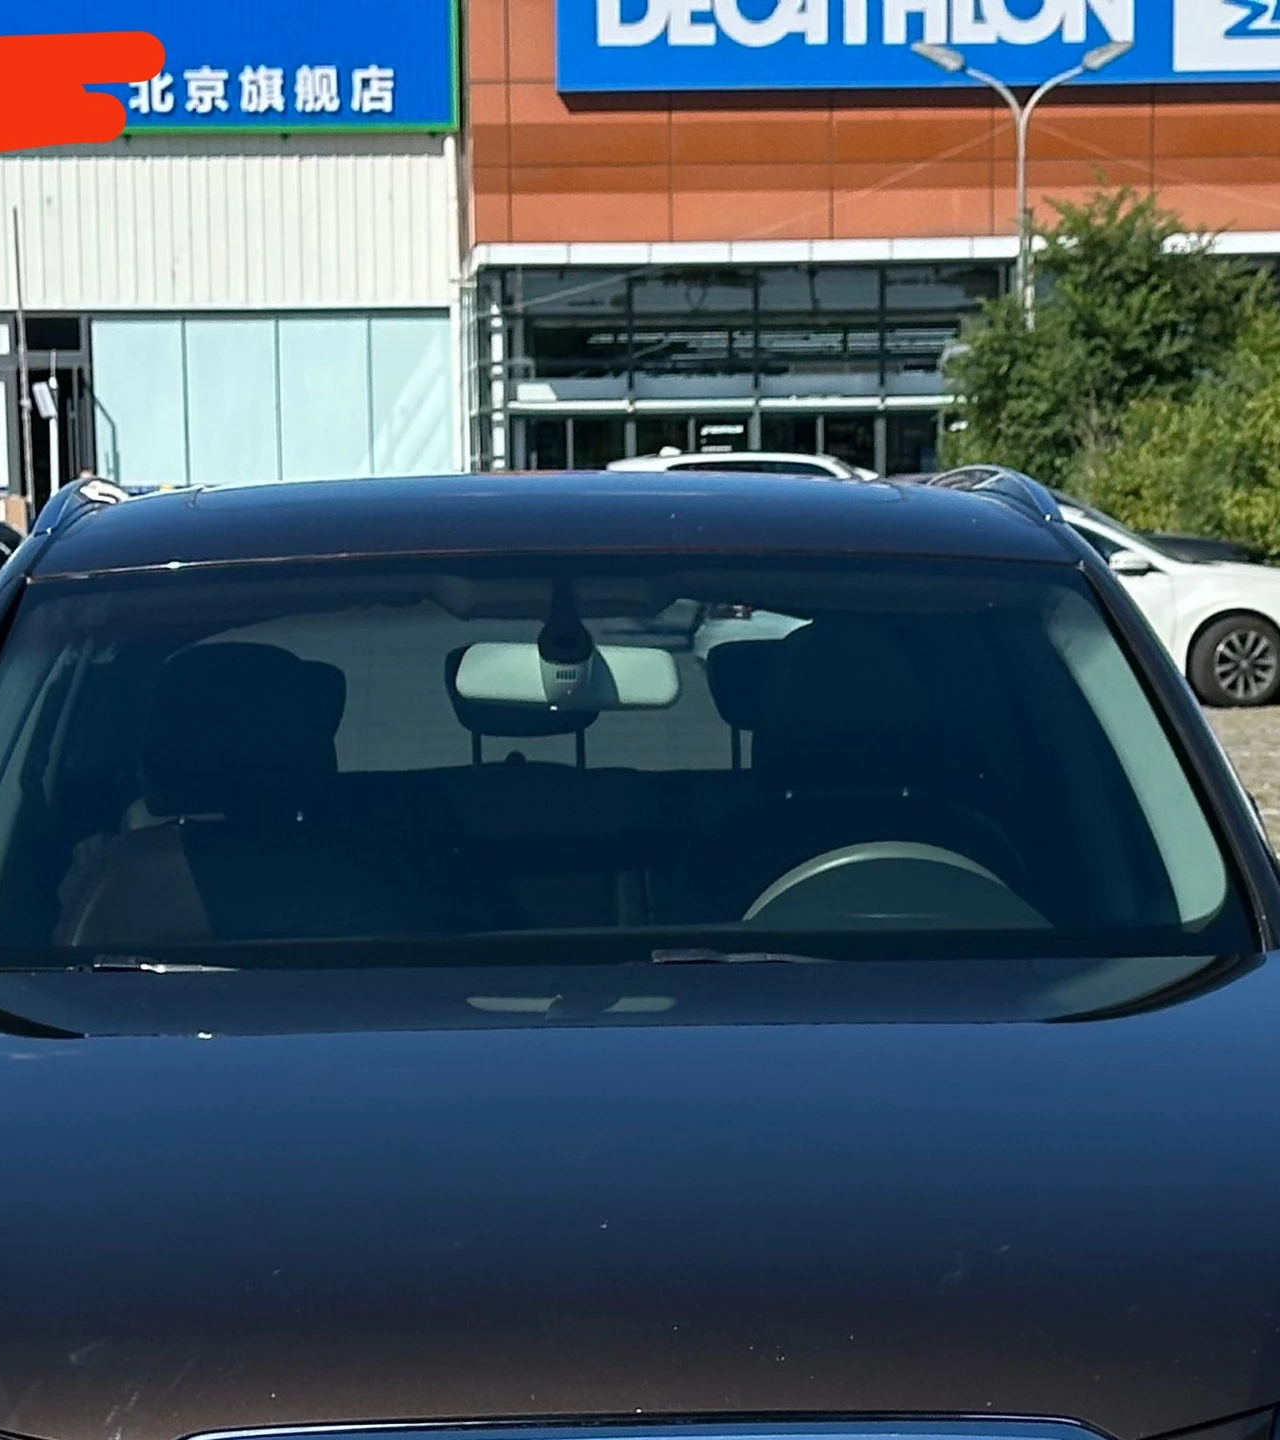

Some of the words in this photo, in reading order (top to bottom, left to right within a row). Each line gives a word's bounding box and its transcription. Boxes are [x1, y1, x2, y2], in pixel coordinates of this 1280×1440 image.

[128, 64, 396, 114] 北京旗舰店
